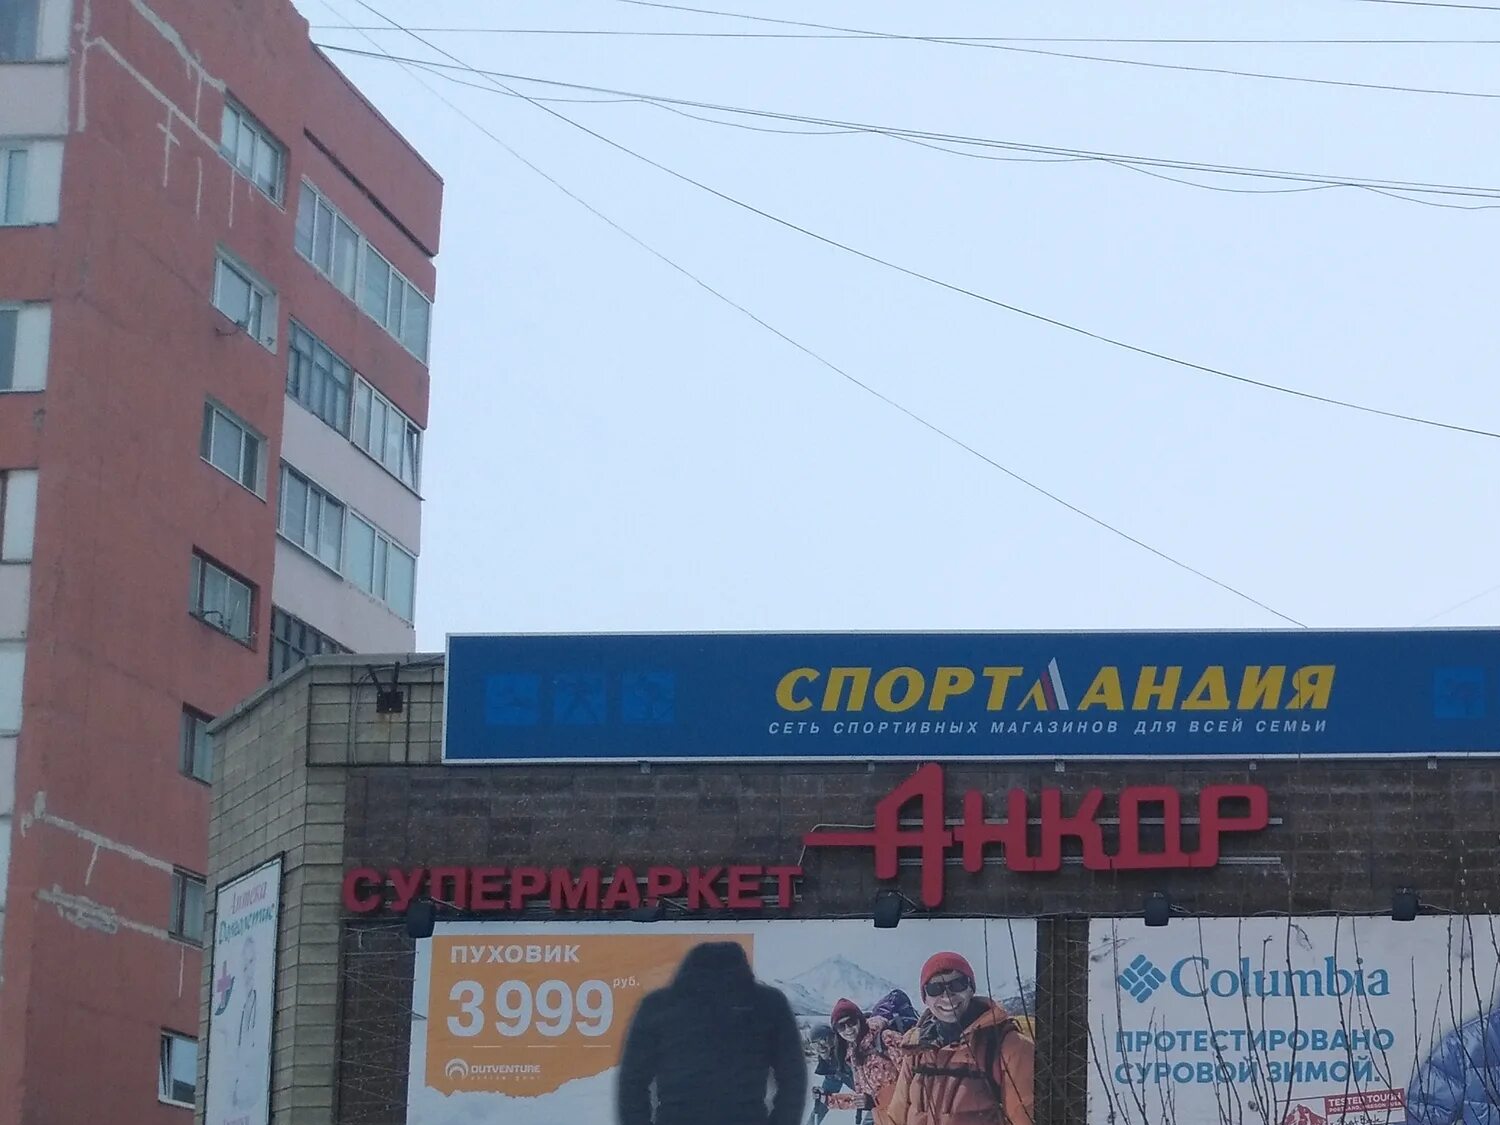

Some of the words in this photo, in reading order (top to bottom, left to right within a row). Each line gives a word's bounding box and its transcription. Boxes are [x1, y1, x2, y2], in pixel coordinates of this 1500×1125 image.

[775, 657, 1336, 711] СПОРТЛАНДИЯ
[768, 720, 820, 735] СЕТЬ
[833, 719, 978, 735] СПОРТИВНЫХ
[990, 718, 1119, 735] МАГАЗИНОВ
[1134, 718, 1177, 735] ДЛЯ
[1188, 717, 1243, 734] ВСЕЙ
[1255, 718, 1327, 733] СЕМЬИ
[342, 864, 805, 914] СУПЕРМАРКЕТ
[451, 944, 581, 964] ПУХОВИК
[613, 976, 640, 988] руб.
[1170, 955, 1391, 999] Columbia
[1115, 1028, 1394, 1053] ПРОТЕСТИРОВАНО
[1114, 1058, 1258, 1084] СУРОВОЙ
[1266, 1056, 1380, 1084] ЗИМОЙ.
